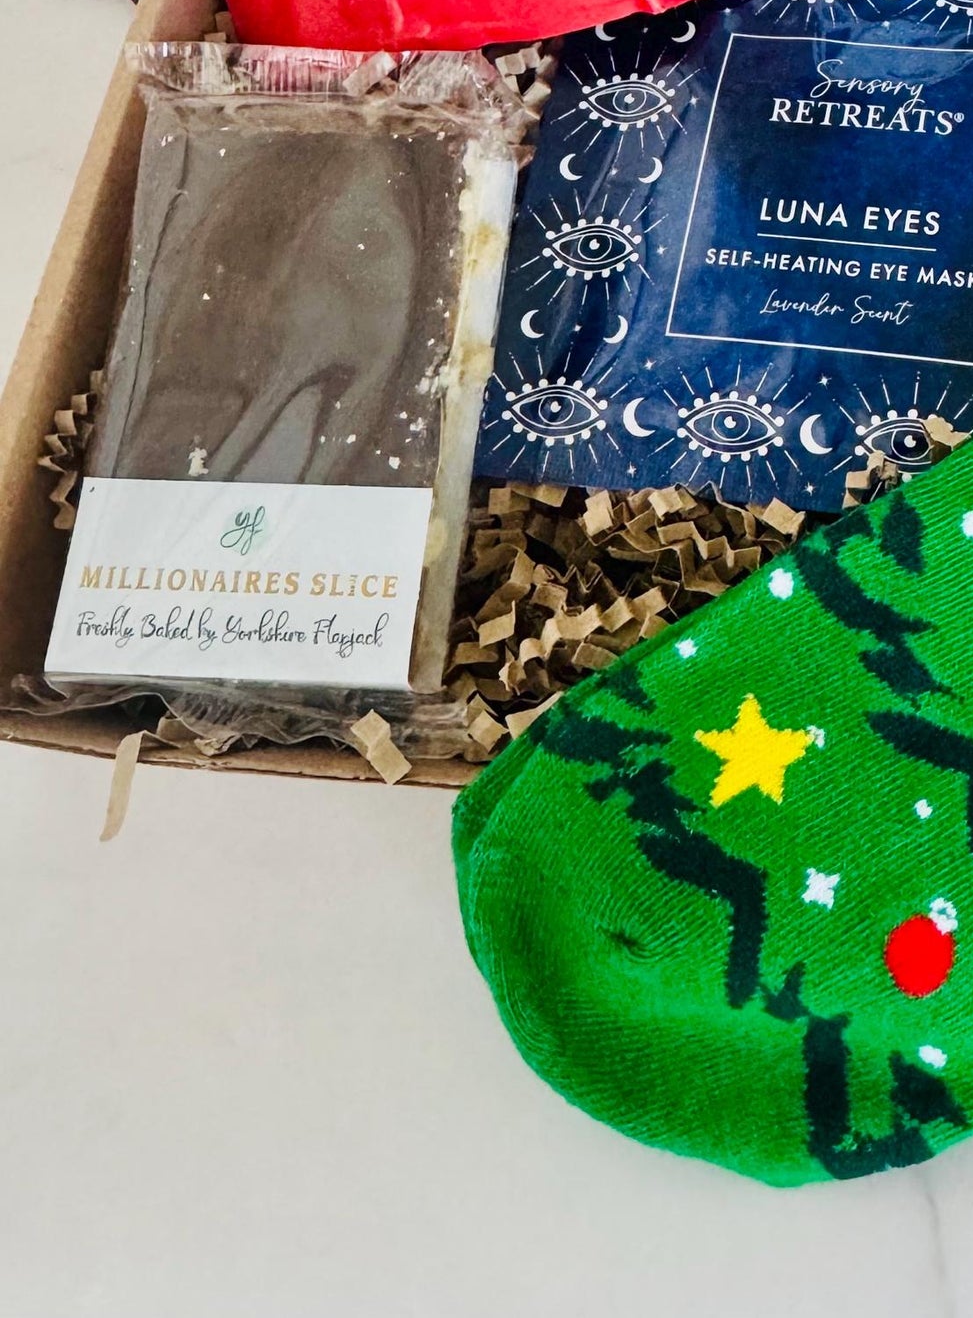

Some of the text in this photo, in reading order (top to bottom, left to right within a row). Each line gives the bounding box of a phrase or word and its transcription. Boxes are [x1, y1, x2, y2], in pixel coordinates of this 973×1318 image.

[810, 58, 926, 112] Sensory
[759, 197, 941, 236] LUNA EYES
[705, 247, 861, 278] SELF-HEATING
[869, 261, 908, 282] EYE
[759, 288, 914, 326] Lavender Scent
[79, 564, 300, 596] MILLIONAIRES
[76, 604, 135, 649] Freshly
[140, 605, 193, 641] Baked
[197, 606, 218, 652] by
[221, 609, 307, 645] Yorkshire
